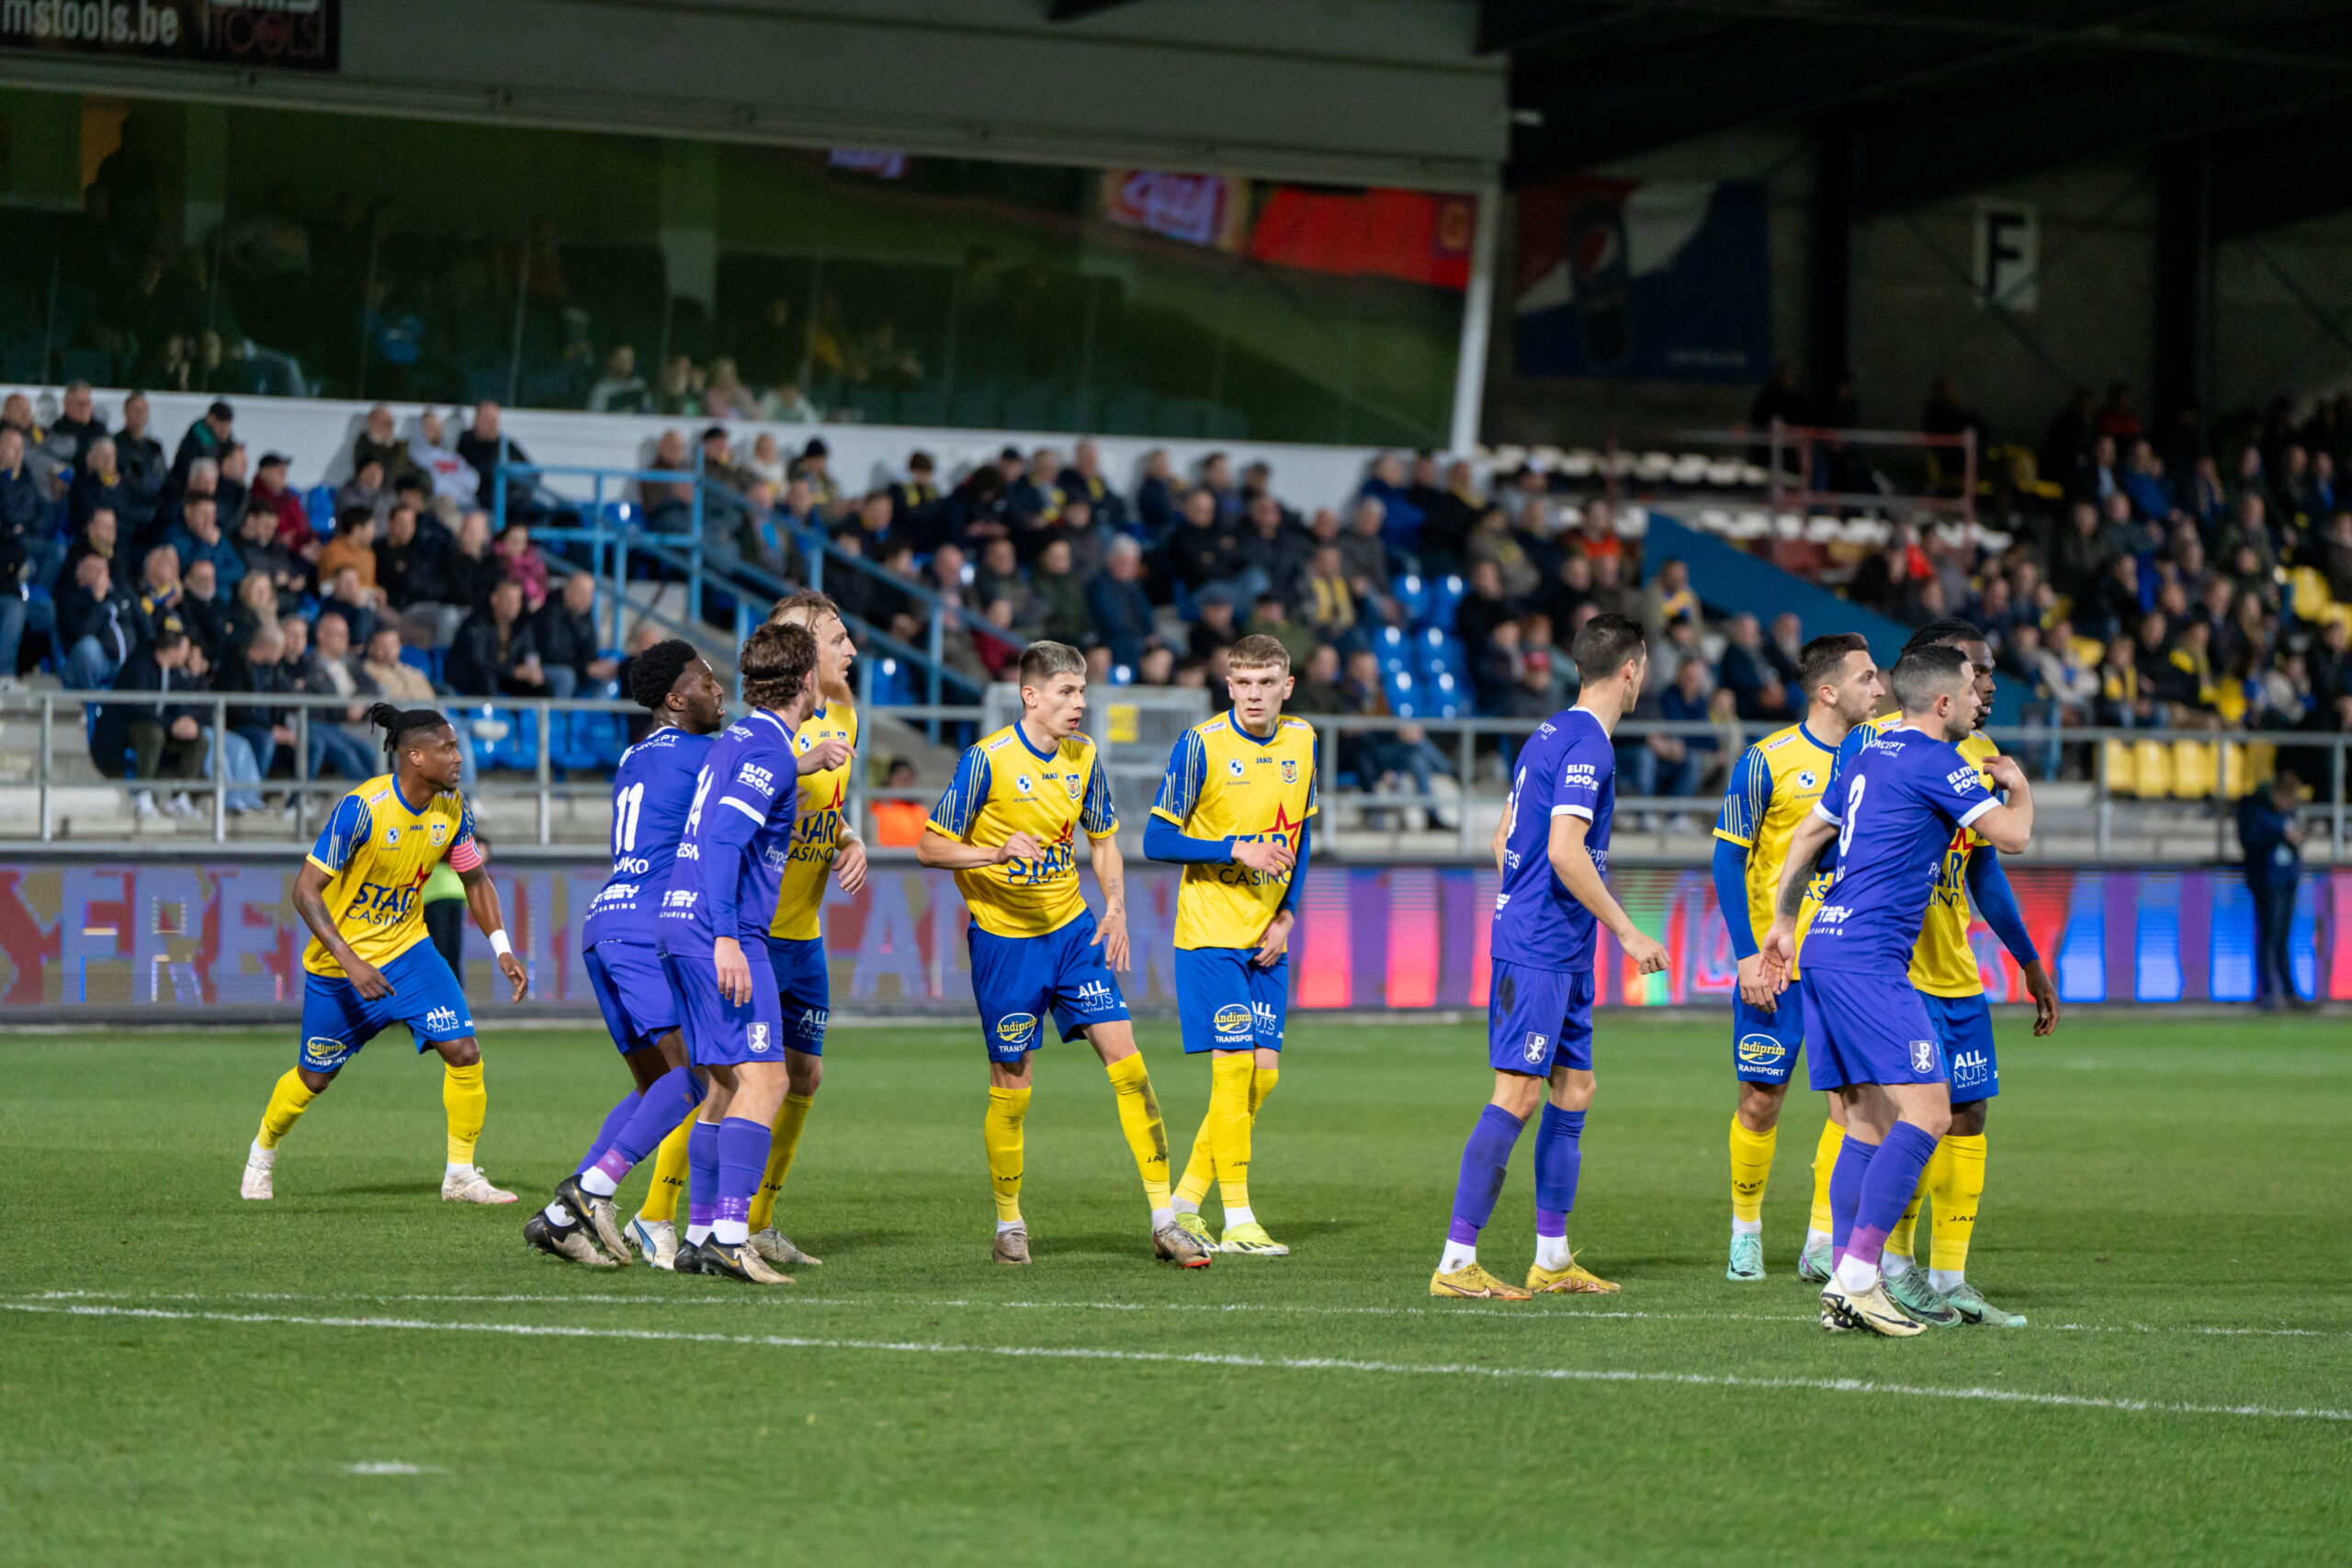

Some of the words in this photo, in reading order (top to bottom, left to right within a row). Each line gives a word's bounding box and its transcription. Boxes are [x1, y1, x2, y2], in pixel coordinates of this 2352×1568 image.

[1989, 213, 2023, 293] F
[742, 762, 774, 782] ELITE
[1566, 763, 1596, 775] ELITE
[739, 772, 775, 796] POOLS
[1565, 774, 1599, 791] POOS
[616, 782, 644, 856] 11
[1838, 774, 1866, 857] 3
[786, 847, 834, 863] ASINO
[1077, 979, 1110, 998] ALL.
[426, 1006, 456, 1022] ALL.
[1738, 1040, 1786, 1056] Andiprim
[1953, 1049, 1987, 1069] ALL.
[1954, 1064, 1988, 1084] NUTS
[662, 1175, 685, 1188] JAK
